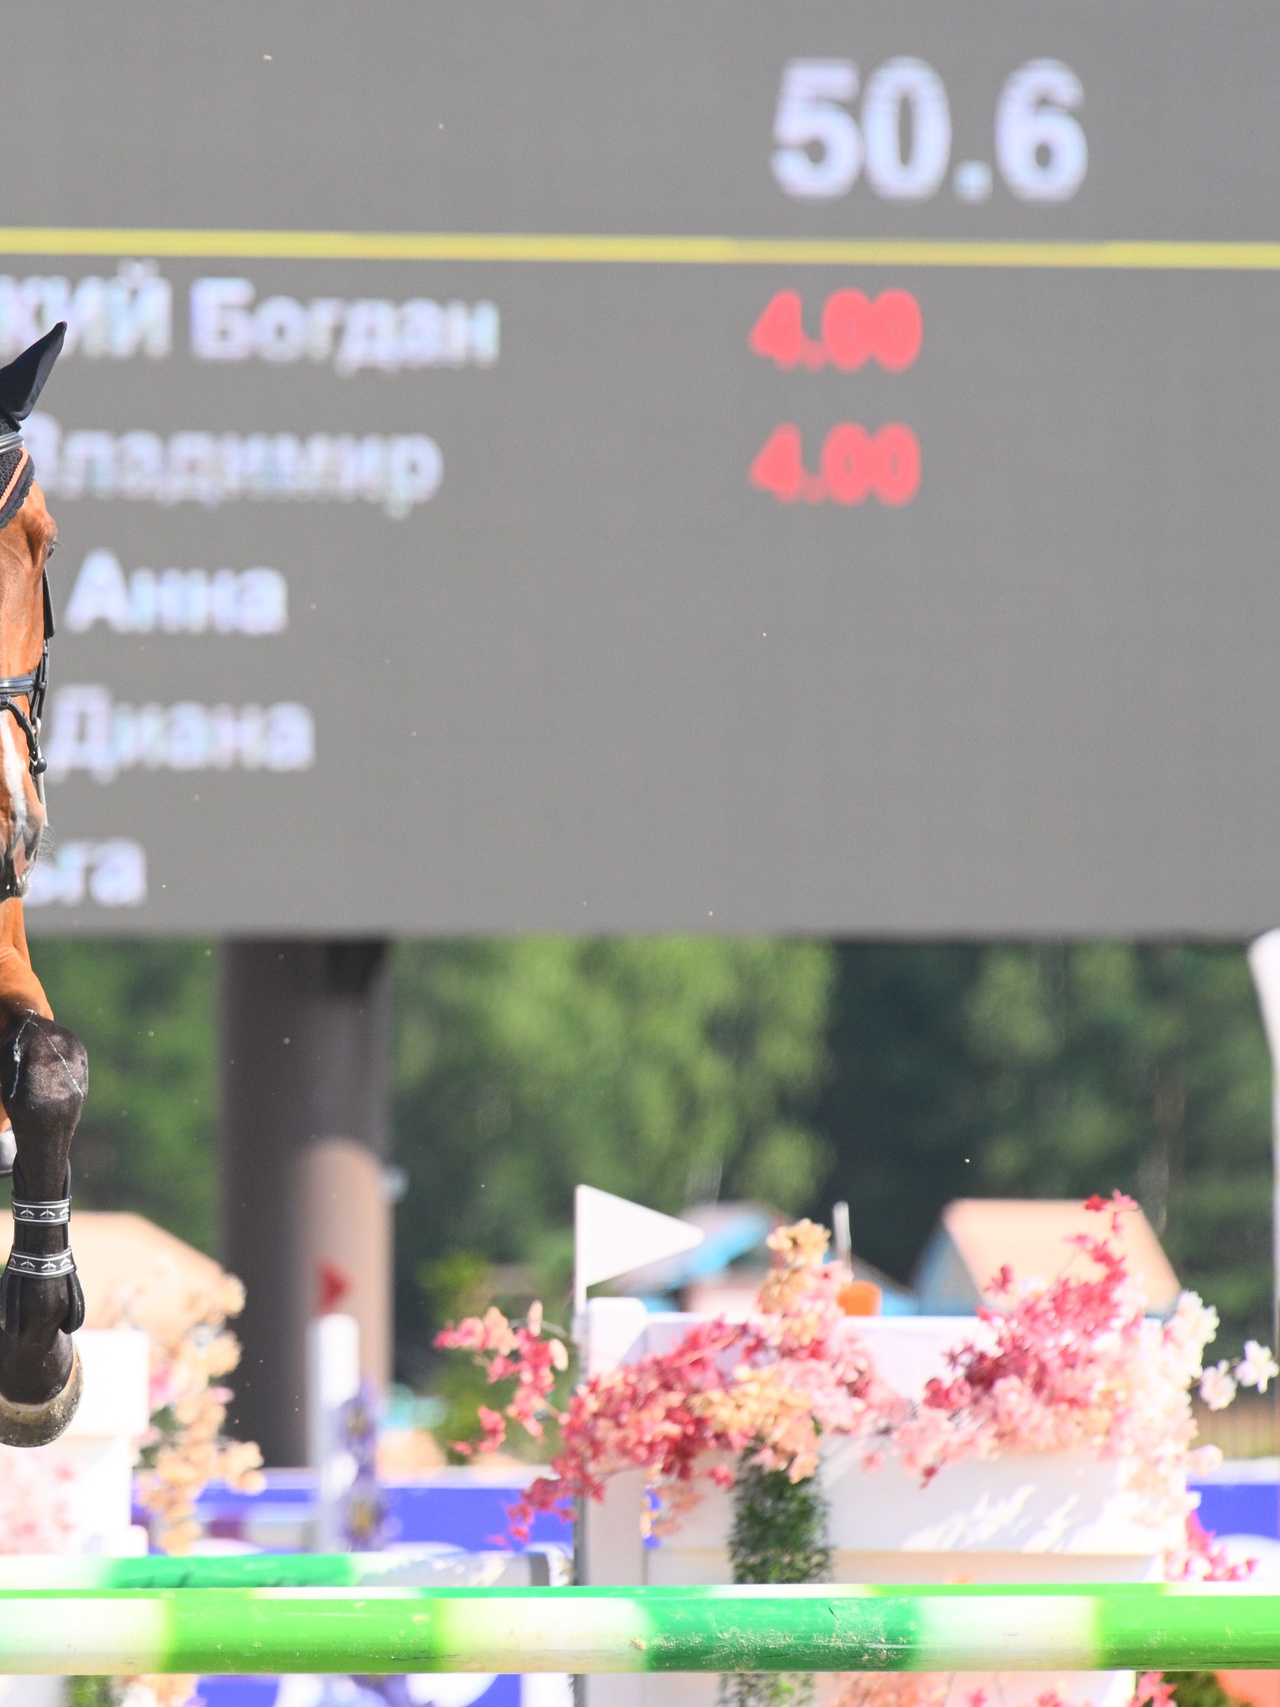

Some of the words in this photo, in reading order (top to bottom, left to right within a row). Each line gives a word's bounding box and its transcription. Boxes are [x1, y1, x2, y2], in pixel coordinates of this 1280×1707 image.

[771, 57, 1088, 203] 50.6
[190, 276, 500, 376] Богдан
[748, 287, 923, 372] 4.00
[748, 421, 922, 507] 4.00
[63, 547, 288, 636] Анна
[45, 683, 316, 785] Диана
